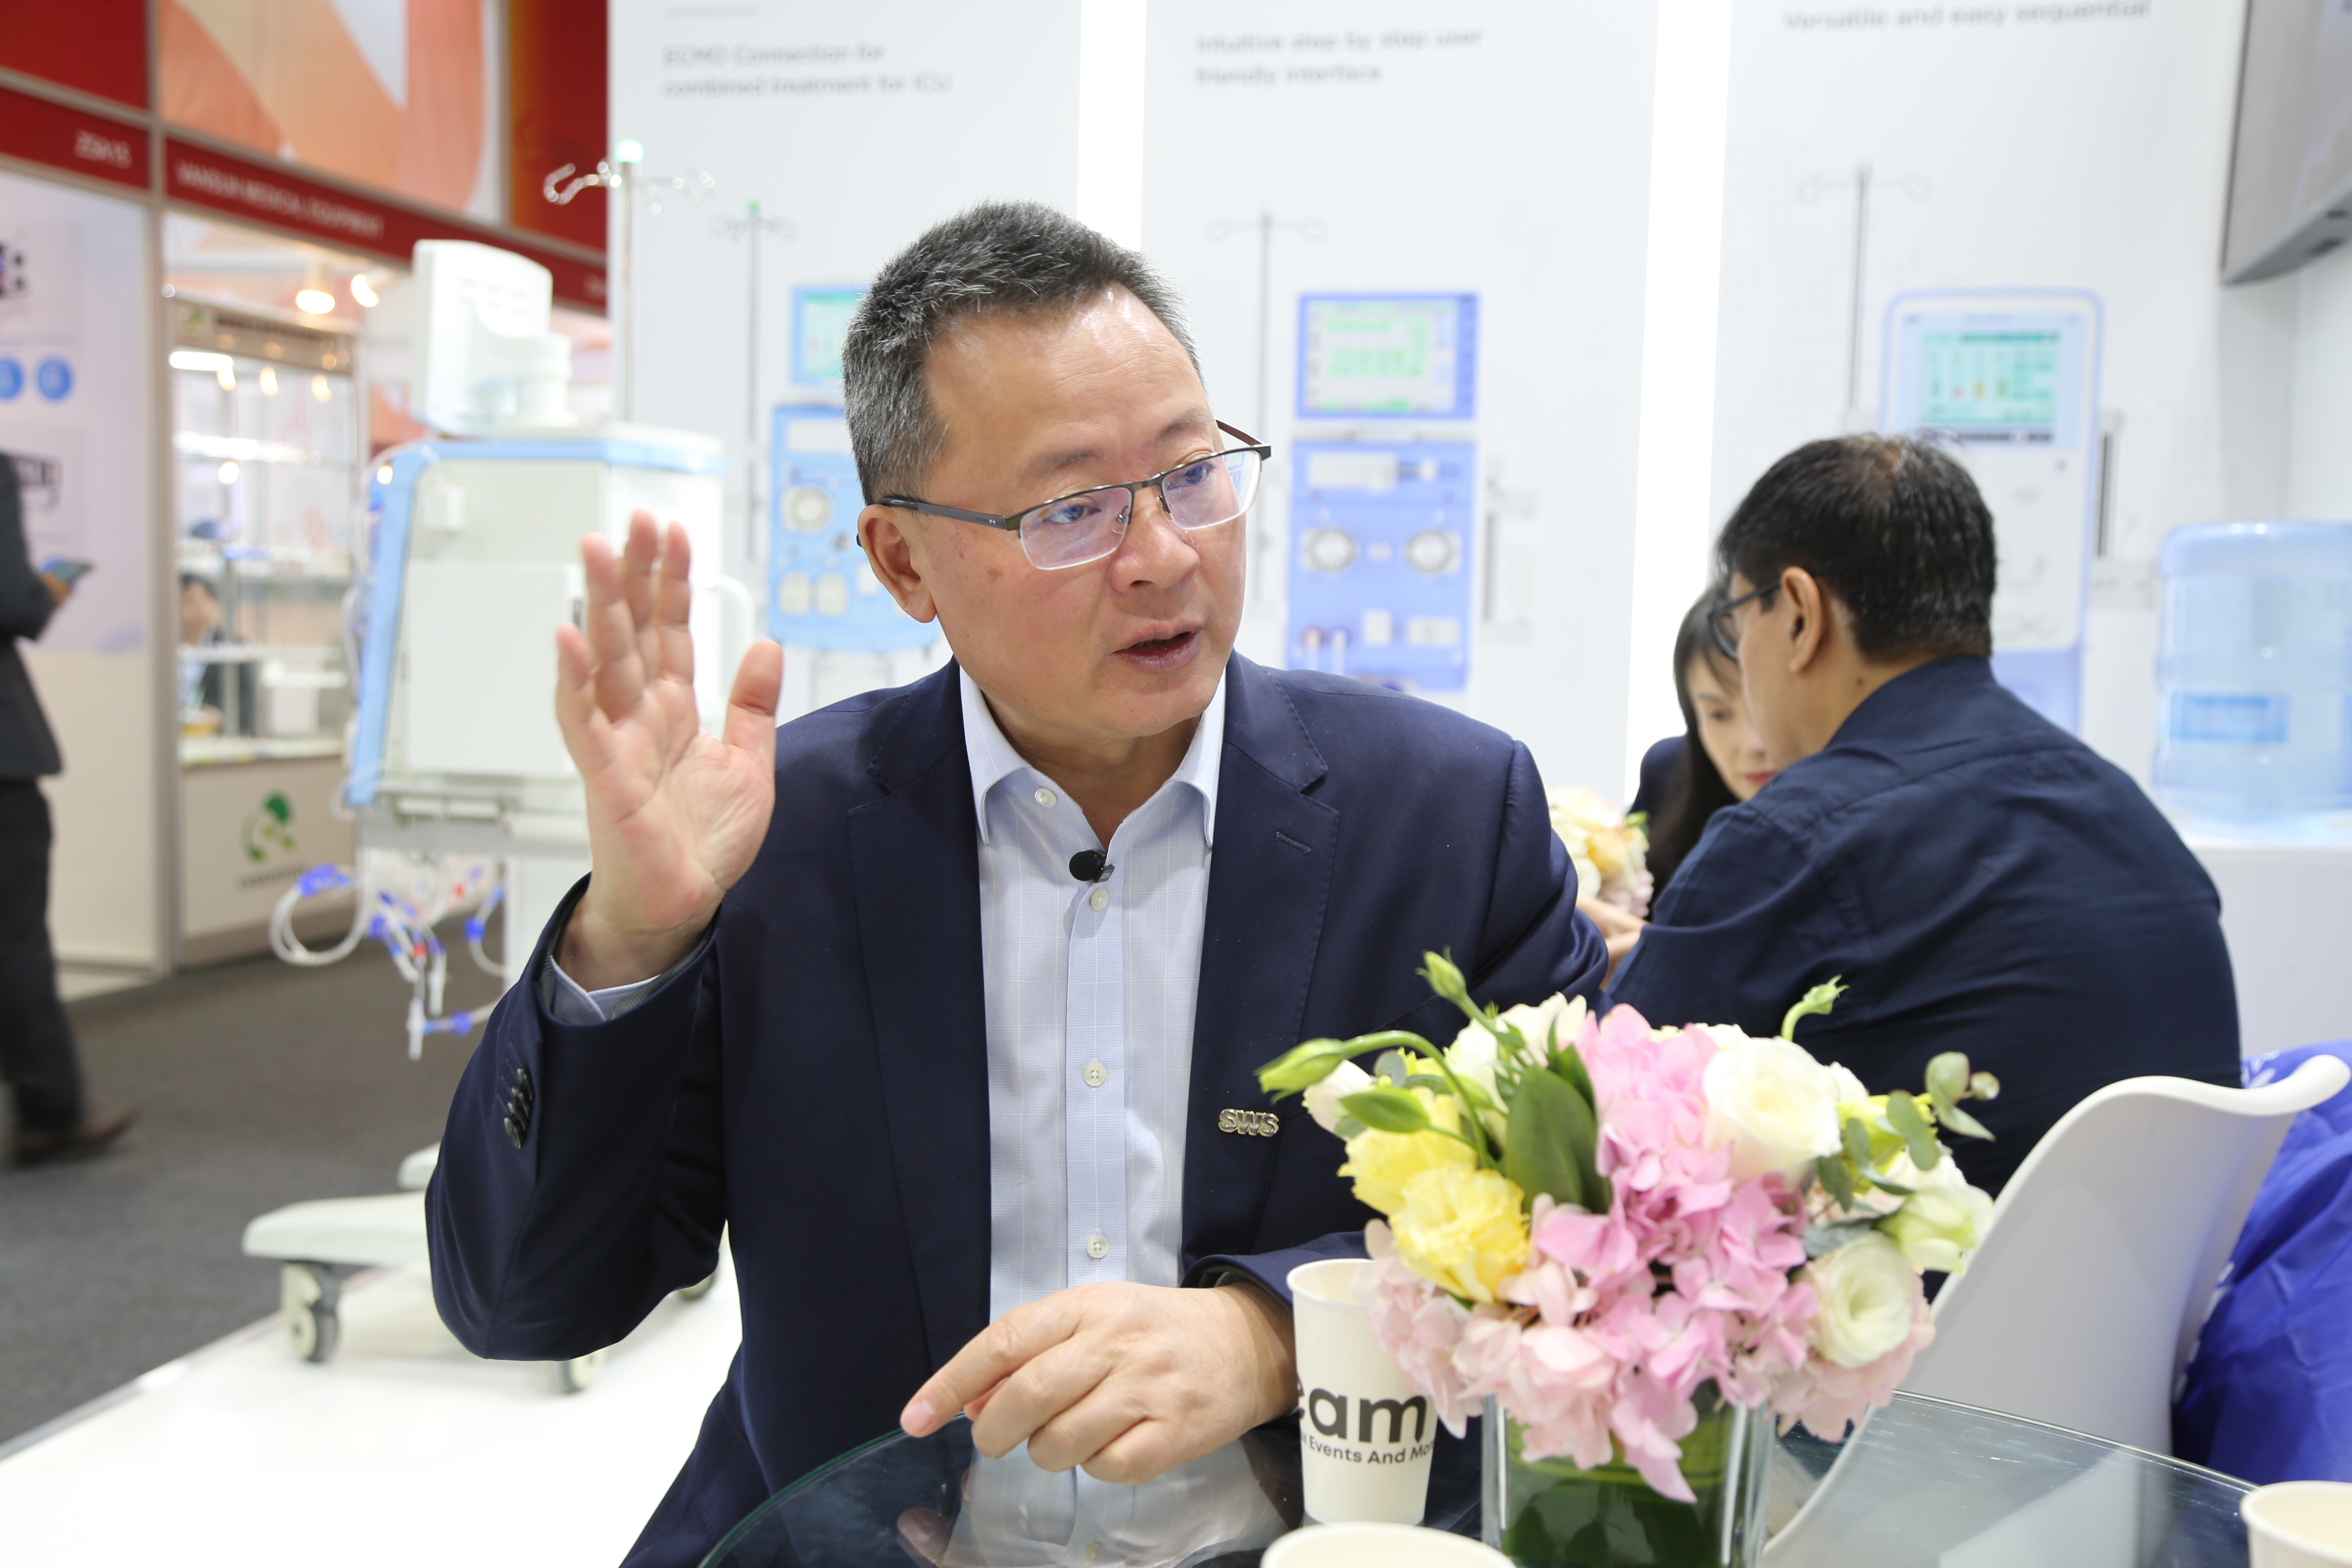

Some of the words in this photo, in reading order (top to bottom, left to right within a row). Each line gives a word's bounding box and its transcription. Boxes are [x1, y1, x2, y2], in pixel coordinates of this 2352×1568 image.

[1782, 7, 1888, 32] Versatile
[1893, 5, 1943, 28] and
[1949, 5, 2007, 28] easy
[2013, 0, 2150, 25] sequential
[663, 45, 728, 67] ECMO
[732, 43, 851, 67] Connection
[854, 40, 886, 64] for
[1289, 30, 1339, 56] step
[1343, 28, 1374, 53] by
[1377, 28, 1428, 52] step
[1433, 27, 1483, 48] user
[662, 76, 765, 98] combined
[770, 75, 871, 96] treatment
[876, 73, 907, 95] for
[911, 71, 951, 94] ICU
[1194, 63, 1278, 88] friendly
[1282, 64, 1383, 85] interface
[1218, 1108, 1279, 1137] SWS
[1310, 1435, 1362, 1463] Events
[1368, 1449, 1405, 1464] And
